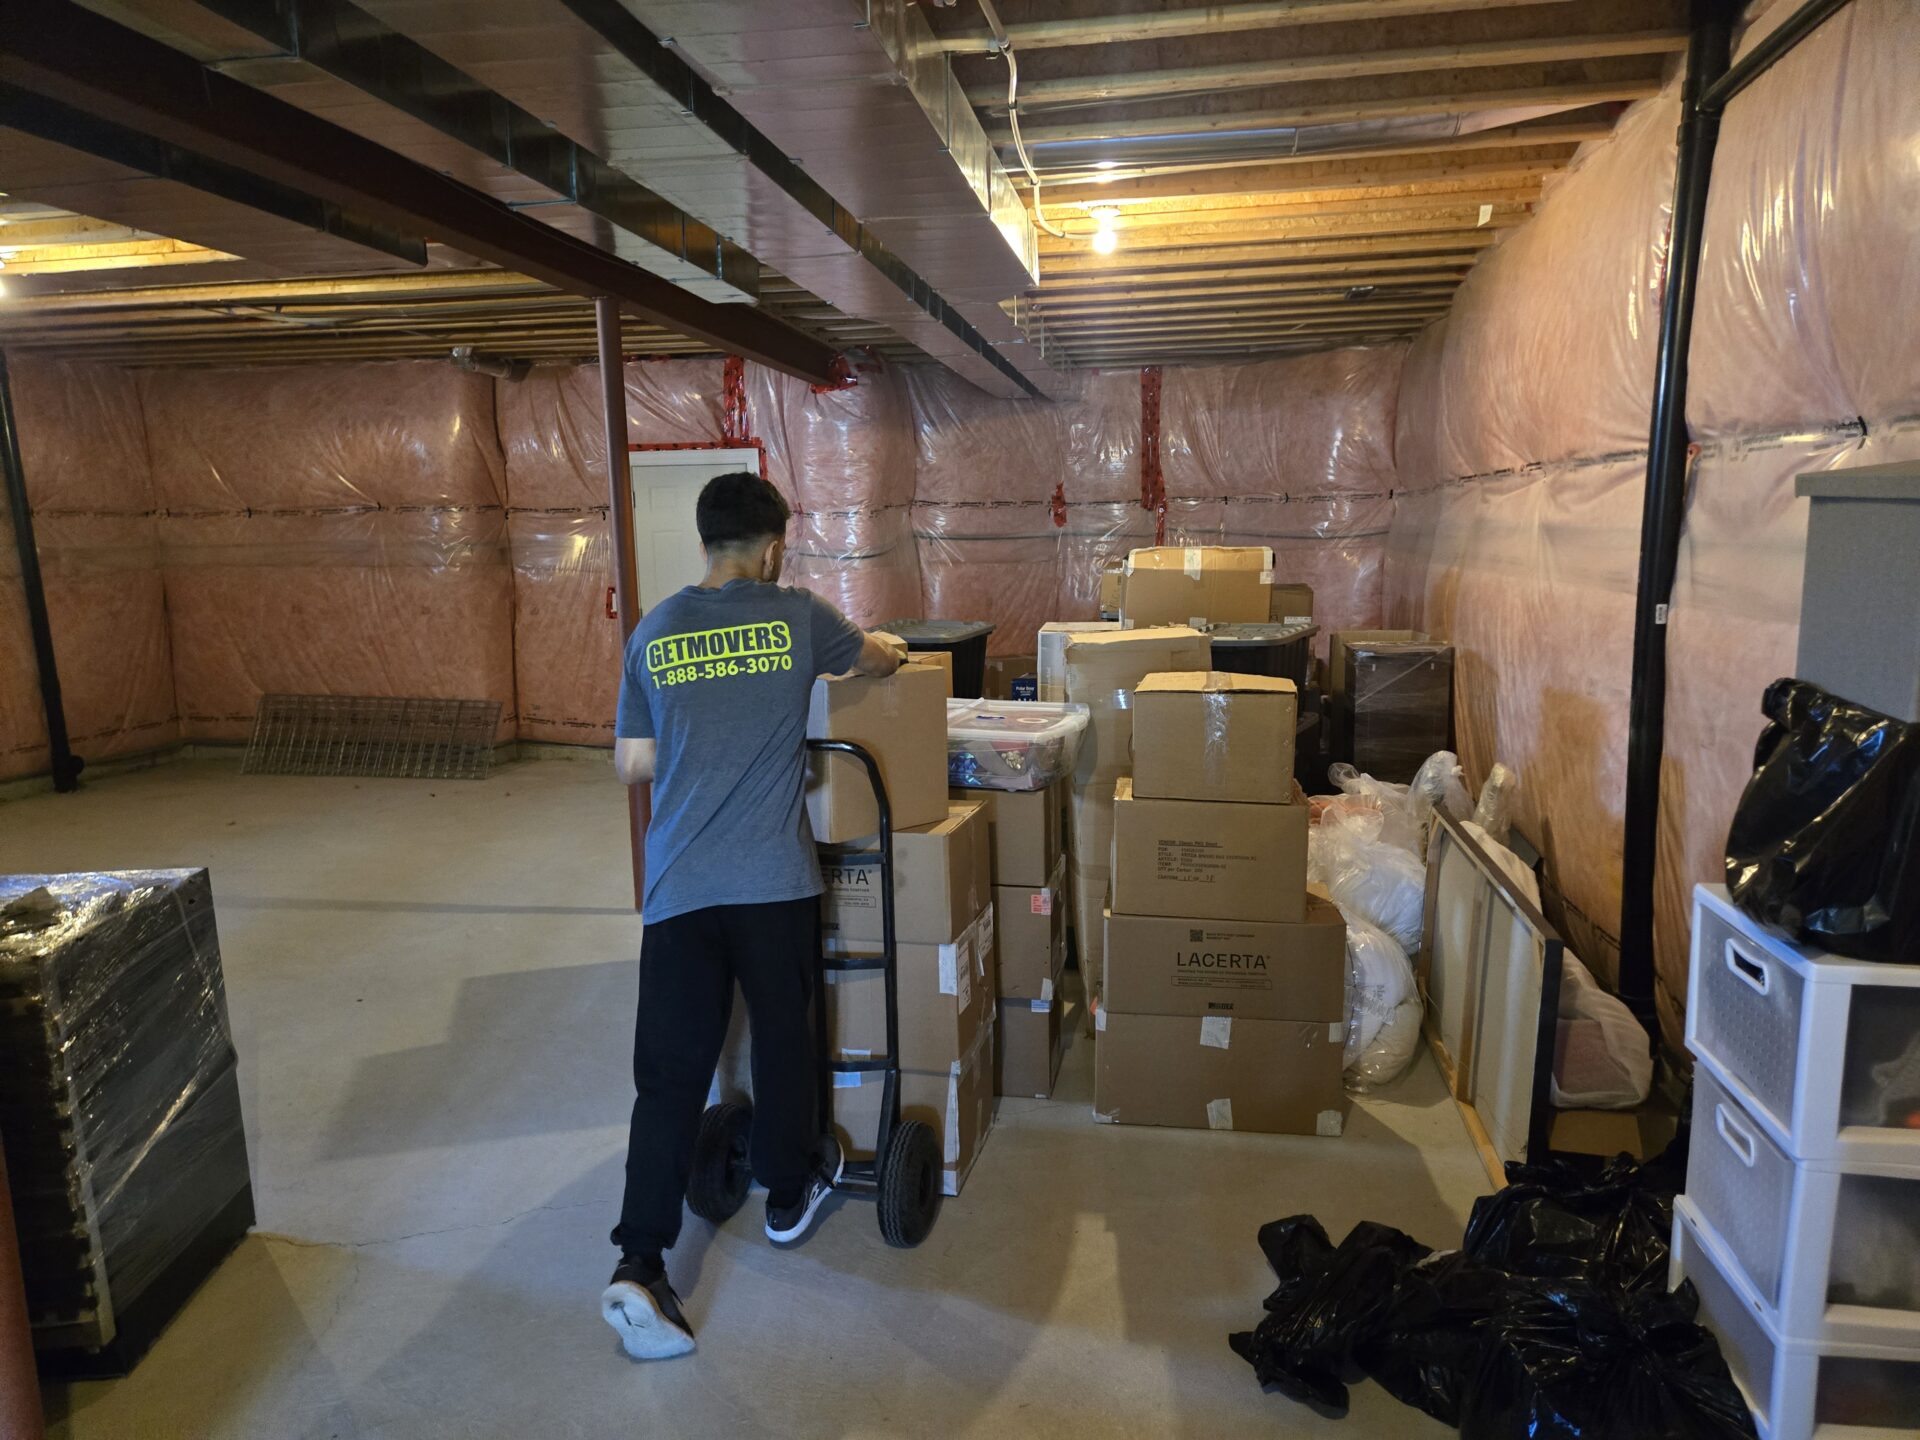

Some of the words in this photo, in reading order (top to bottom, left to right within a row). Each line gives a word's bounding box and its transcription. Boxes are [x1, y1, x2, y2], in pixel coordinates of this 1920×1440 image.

[649, 623, 789, 669] GETMOVERS
[652, 654, 793, 690] 1-888-586-3070
[1177, 951, 1267, 970] LACERTA
